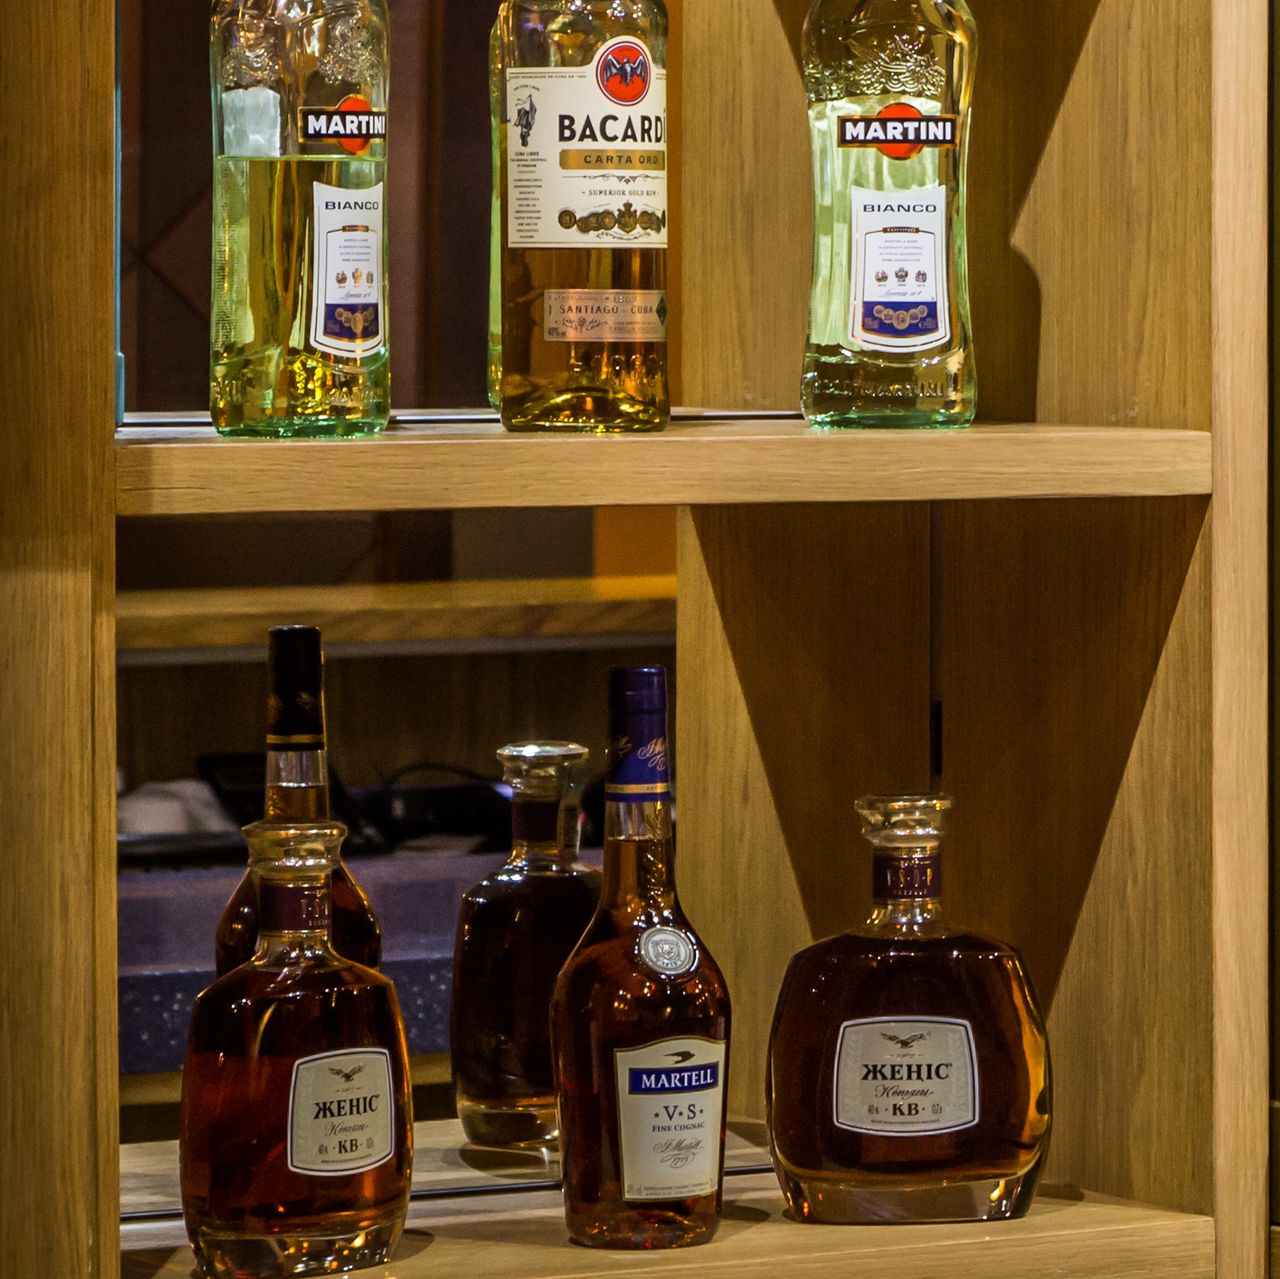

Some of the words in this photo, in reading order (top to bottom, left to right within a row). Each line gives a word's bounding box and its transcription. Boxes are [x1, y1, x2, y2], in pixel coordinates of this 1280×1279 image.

[308, 114, 386, 134] MARTINI
[845, 121, 952, 140] MARTINI
[584, 155, 633, 165] CARTA
[638, 156, 658, 165] ORO
[325, 201, 379, 210] BIANCO
[863, 204, 937, 213] BIANCO
[560, 305, 619, 314] SANTIAGO
[630, 306, 653, 314] CUBA
[641, 1069, 714, 1089] MARTELL
[652, 1124, 672, 1132] FINE
[674, 1122, 705, 1132] COGNAC
